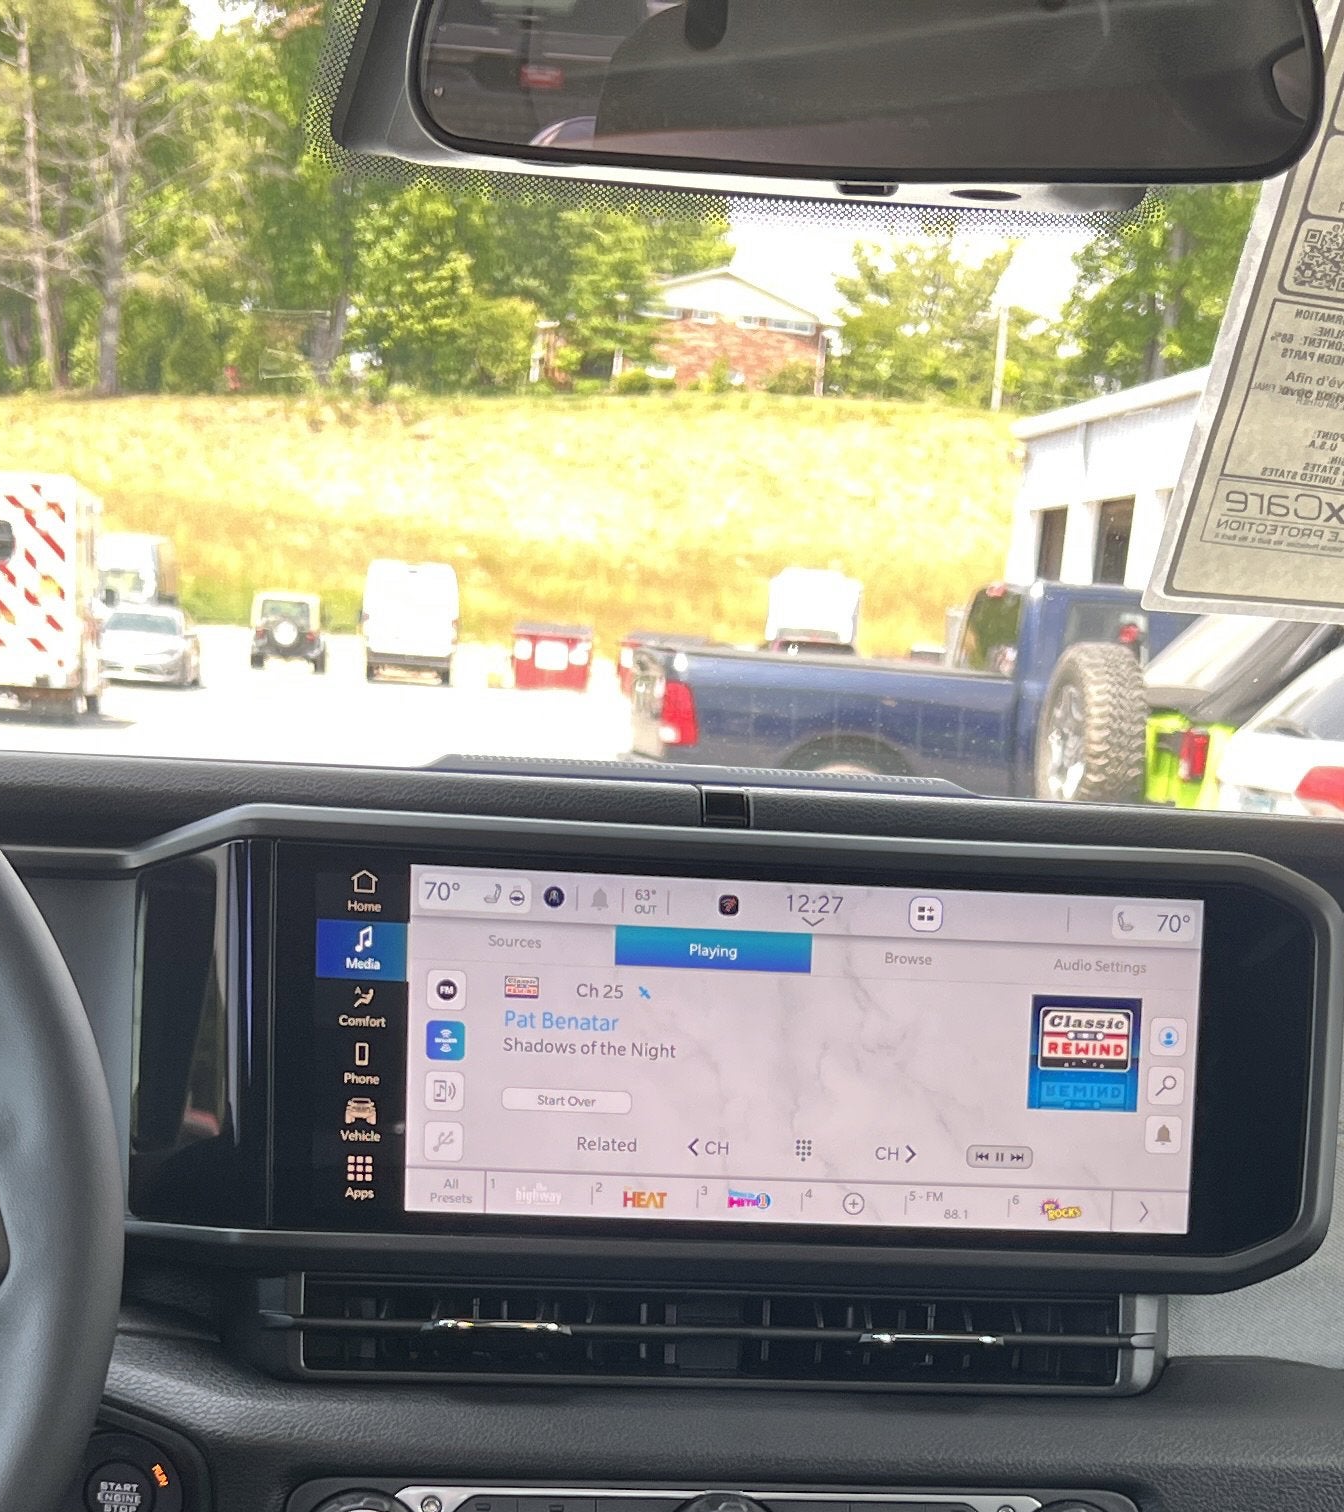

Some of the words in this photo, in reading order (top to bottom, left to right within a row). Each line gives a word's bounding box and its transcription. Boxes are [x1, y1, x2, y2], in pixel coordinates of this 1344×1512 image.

[424, 881, 460, 902] 70°
[634, 889, 656, 901] 63°
[347, 900, 381, 913] Home
[634, 904, 657, 915] OUT
[787, 895, 844, 915] 12:27
[1156, 914, 1190, 933] 70°
[488, 935, 542, 949] Sources
[688, 943, 738, 961] Playing
[885, 951, 932, 966] Browse
[346, 957, 381, 970] Media
[1054, 958, 1092, 973] Audio
[1095, 959, 1147, 976] Settings
[440, 986, 454, 994] FM
[577, 984, 598, 999] Ch
[602, 985, 624, 999] 25
[339, 1015, 386, 1028] Comfort
[505, 1011, 537, 1029] Pat
[542, 1012, 619, 1031] Benatar
[1048, 1014, 1125, 1031] Classic
[503, 1037, 576, 1055] Shadows
[580, 1040, 596, 1055] of
[600, 1041, 626, 1056] the
[631, 1042, 676, 1060] Night
[1047, 1041, 1124, 1057] REWIND
[344, 1073, 380, 1085] Phone
[537, 1095, 564, 1107] Start
[568, 1096, 596, 1108] Over
[340, 1130, 381, 1143] Vehicle
[577, 1137, 638, 1152] Related
[704, 1141, 729, 1156] CH
[875, 1147, 899, 1161] CH
[444, 1178, 459, 1190] All
[345, 1187, 374, 1200] Apps
[430, 1192, 472, 1204] Presets
[623, 1191, 667, 1209] HEAT
[927, 1192, 943, 1201] FM
[944, 1209, 967, 1219] 88.1
[152, 1463, 169, 1487] RUN
[101, 1481, 138, 1492] START
[97, 1492, 141, 1505] ENGINE
